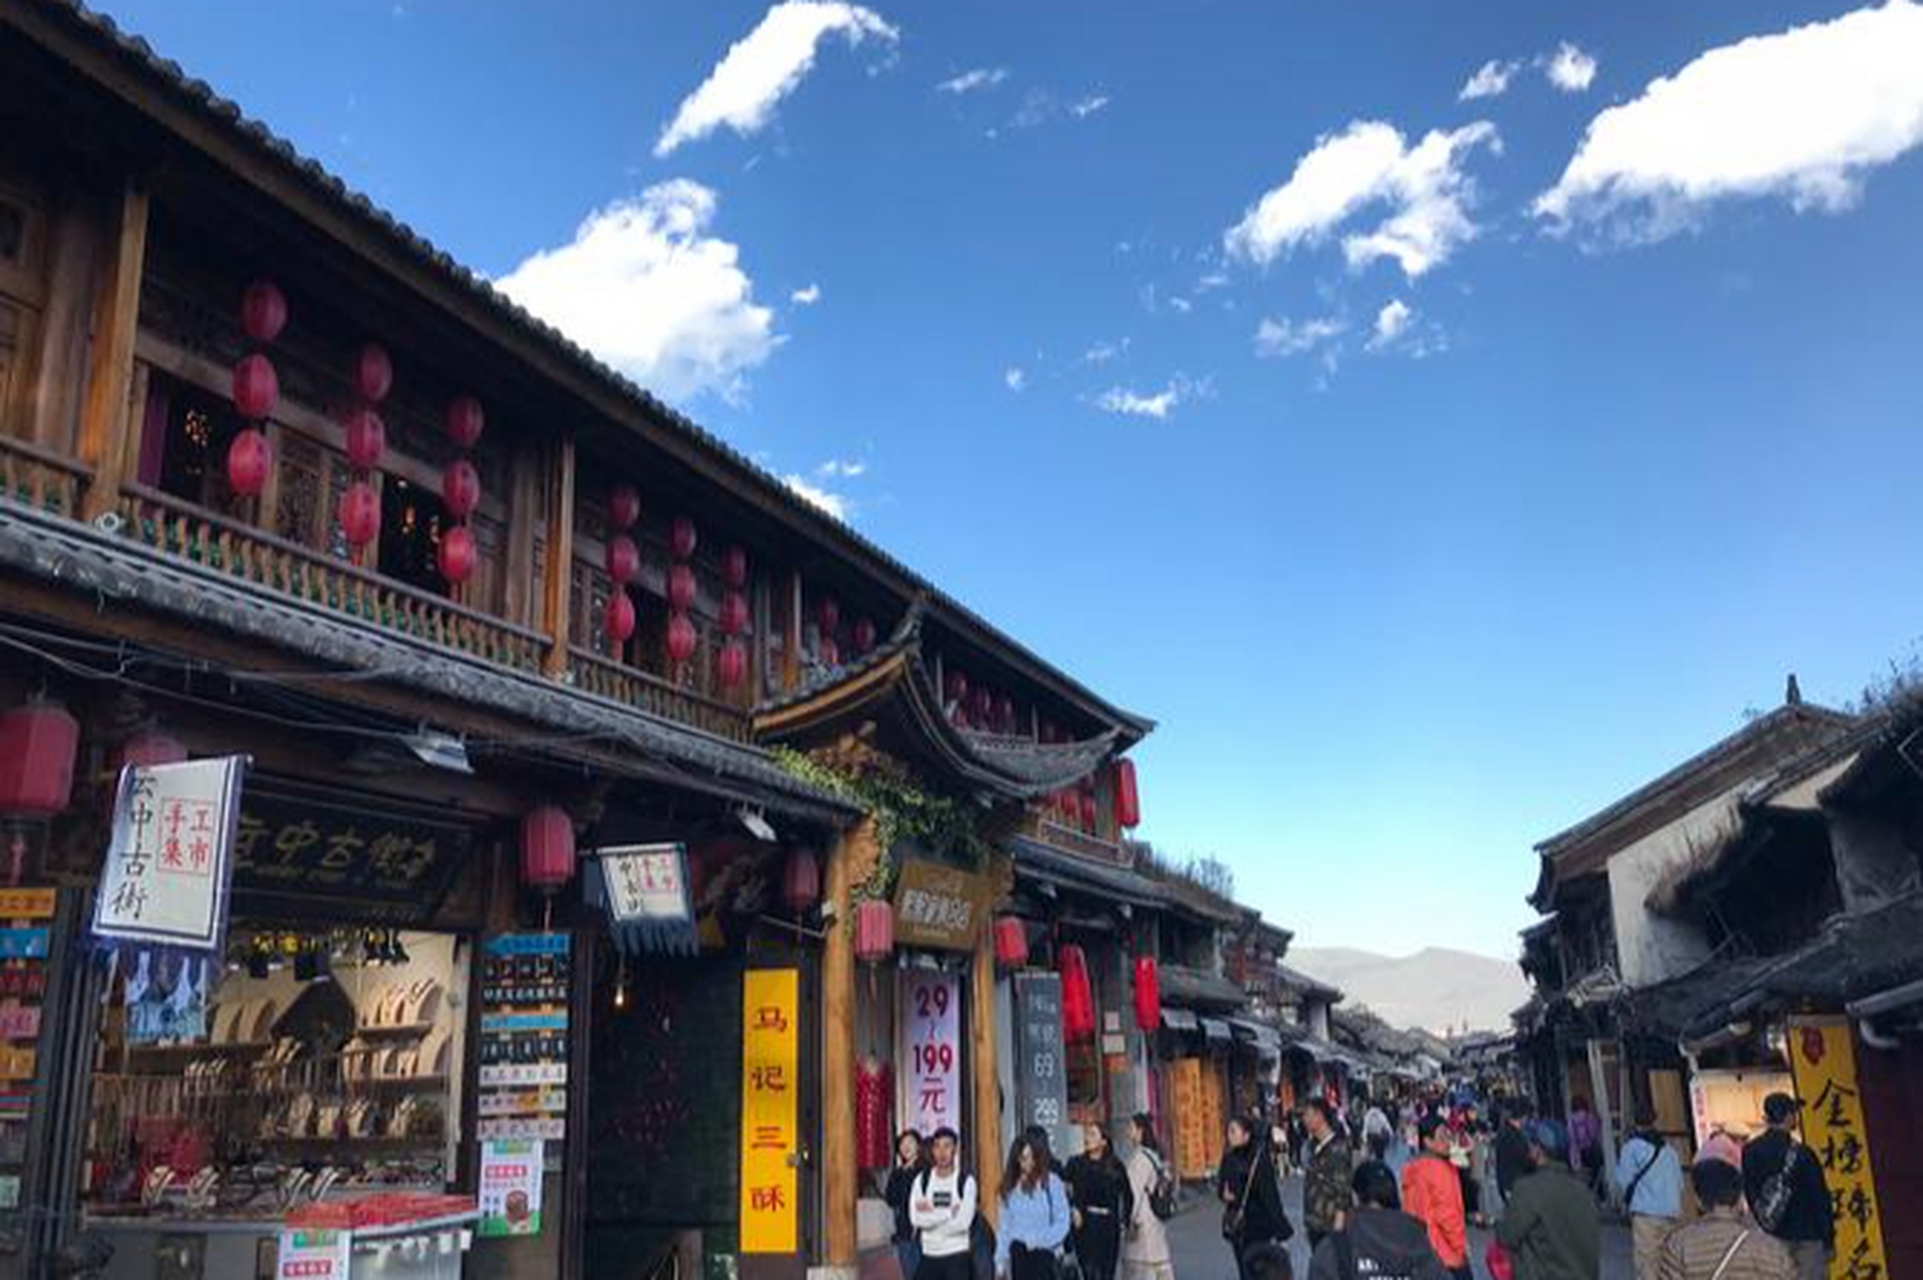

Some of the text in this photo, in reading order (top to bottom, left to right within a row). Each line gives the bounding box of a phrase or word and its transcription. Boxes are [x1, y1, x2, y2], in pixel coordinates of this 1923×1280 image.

[915, 985, 949, 1017] 29
[913, 1043, 953, 1074] 199
[920, 1077, 946, 1113] 元
